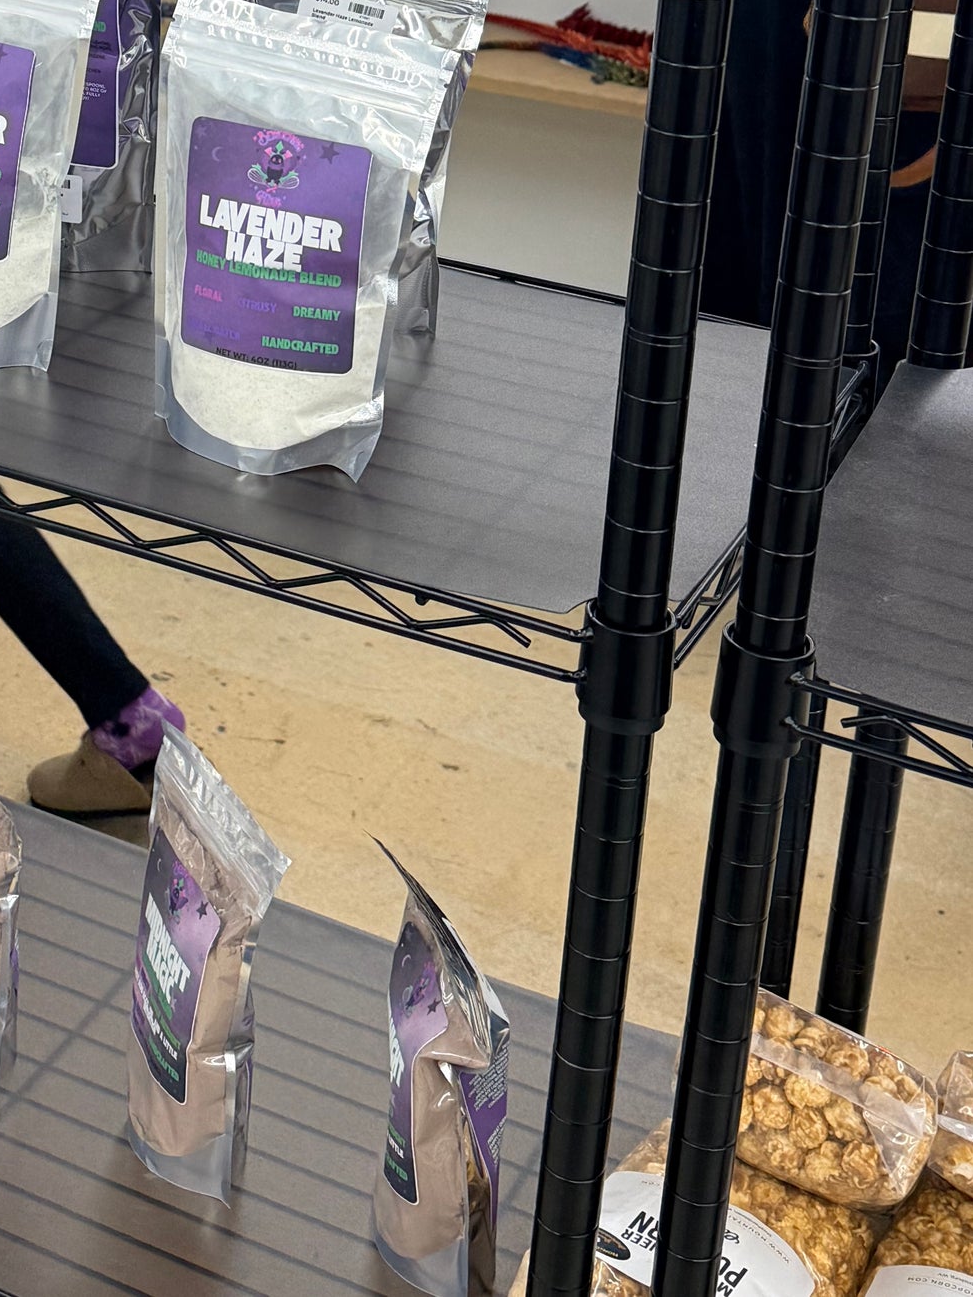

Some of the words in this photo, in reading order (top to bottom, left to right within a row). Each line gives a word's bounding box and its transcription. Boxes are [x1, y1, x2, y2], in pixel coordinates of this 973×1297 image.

[311, 12, 326, 20] Blend
[312, 7, 335, 17] Lavender
[348, 16, 374, 27] Lemonade
[199, 194, 343, 252] LAVENDER
[225, 231, 303, 273] HAZE
[196, 249, 226, 270] HONEY
[228, 259, 296, 283] LEMONADE
[299, 271, 342, 288] BLEND
[195, 284, 222, 302] FLORAL
[293, 305, 341, 321] DREAMY
[261, 336, 339, 355] HANDCRAFTED
[216, 347, 231, 357] NET
[233, 351, 249, 362] WT:
[251, 354, 269, 365] 4OZ
[272, 357, 297, 370] (113G)
